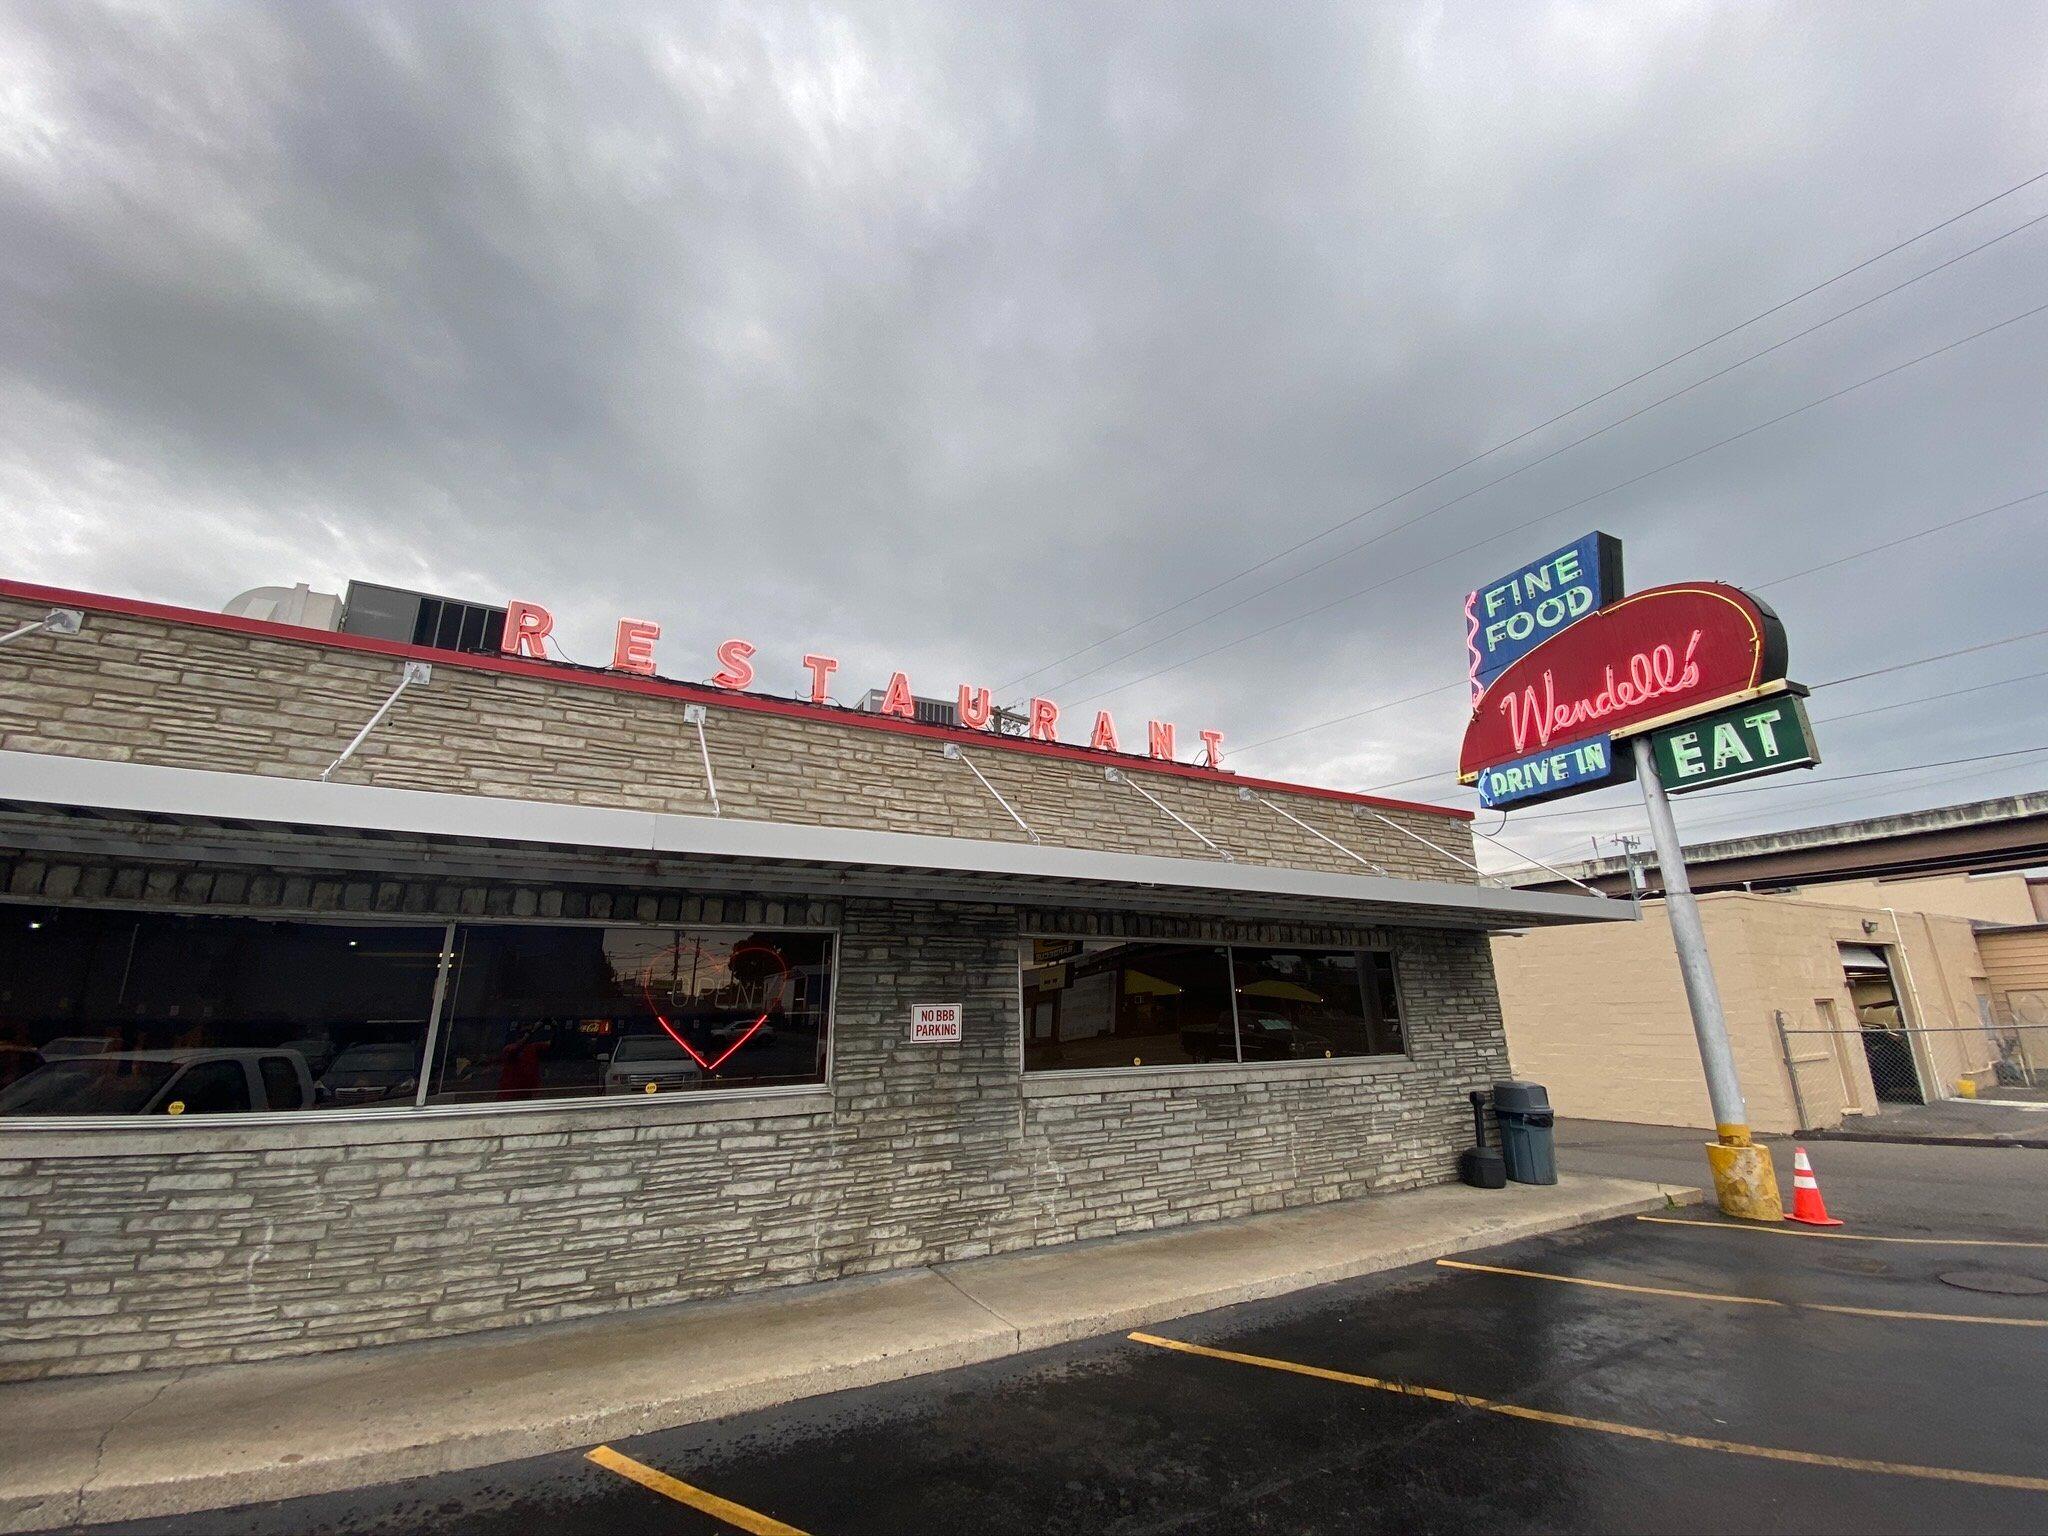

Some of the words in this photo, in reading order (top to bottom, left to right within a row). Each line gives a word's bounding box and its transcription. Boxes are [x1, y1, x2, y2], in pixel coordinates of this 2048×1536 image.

[1485, 550, 1581, 618] FINE
[1486, 585, 1594, 652] FOOD
[501, 599, 1224, 767] RESTAURANT
[1491, 754, 1567, 797] DRIVE
[1576, 742, 1607, 776] IN
[1670, 709, 1782, 778] EAT
[671, 976, 756, 1010] OPEN
[921, 1010, 934, 1022] NO
[936, 1010, 955, 1021] BBB
[916, 1024, 957, 1037] PARKING
